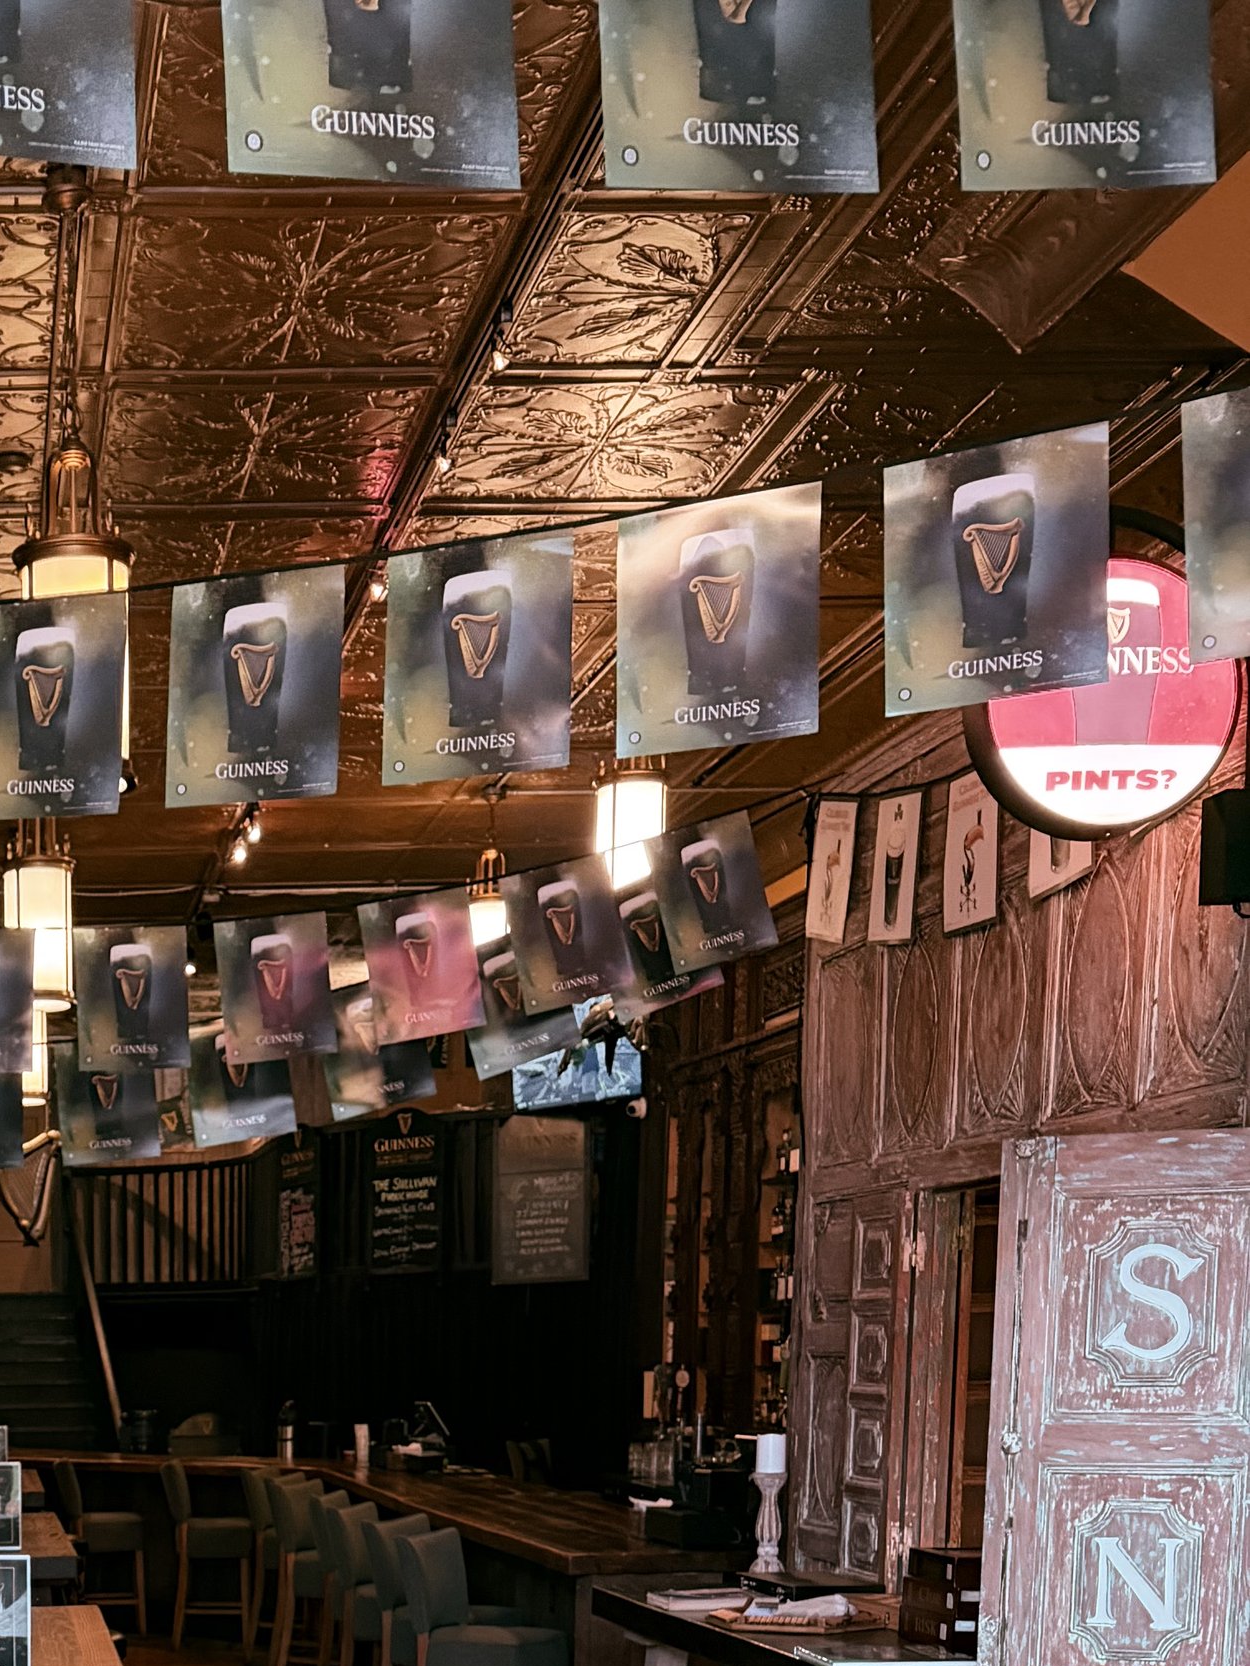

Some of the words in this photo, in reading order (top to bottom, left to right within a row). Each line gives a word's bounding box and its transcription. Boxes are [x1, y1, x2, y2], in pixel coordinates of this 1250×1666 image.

[310, 105, 435, 140] GUINNESS
[683, 117, 799, 147] GUINNESS
[1031, 120, 1140, 145] GUINNESS
[948, 649, 1044, 680] GUINNESS
[674, 698, 761, 724] GUINNESS
[436, 731, 516, 756] GUINNESS
[215, 760, 289, 779] GUINNESS
[1045, 767, 1178, 794] PINTS?
[7, 778, 75, 797] GUINNESS
[700, 929, 745, 951] GUINNESS
[552, 973, 599, 993] GUINNESS
[643, 974, 691, 998] GUINNESS
[110, 1044, 158, 1056] GUINNESS
[256, 1032, 304, 1047] GUINNESS
[89, 1137, 132, 1151] GUINNESS
[374, 1135, 435, 1153] GUINNESS
[372, 1179, 390, 1192] THE
[392, 1176, 438, 1190] SULLIVAN
